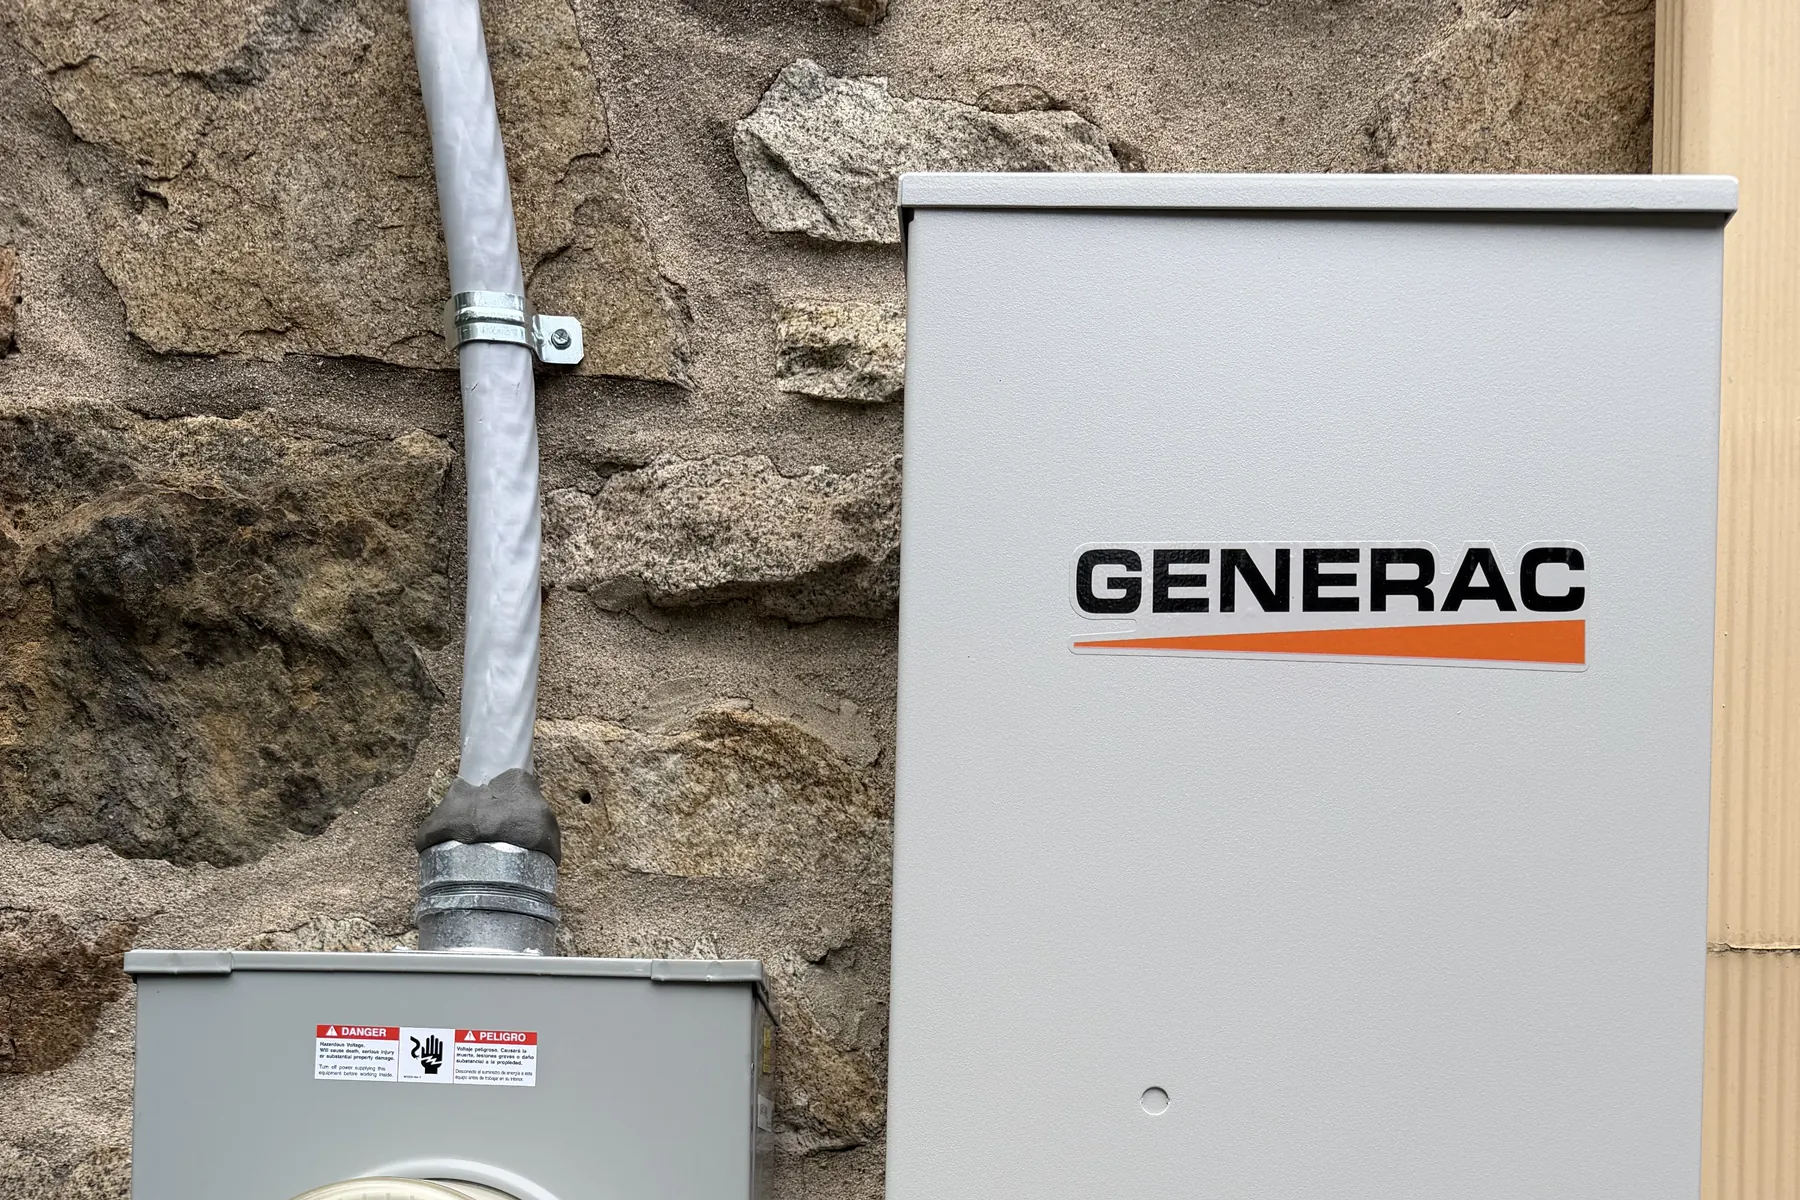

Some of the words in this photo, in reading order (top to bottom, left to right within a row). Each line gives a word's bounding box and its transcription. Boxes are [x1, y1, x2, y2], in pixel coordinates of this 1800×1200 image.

[1075, 546, 1586, 615] GENERAC
[341, 1027, 387, 1037] DANGER
[479, 1031, 526, 1042] PELIGRO
